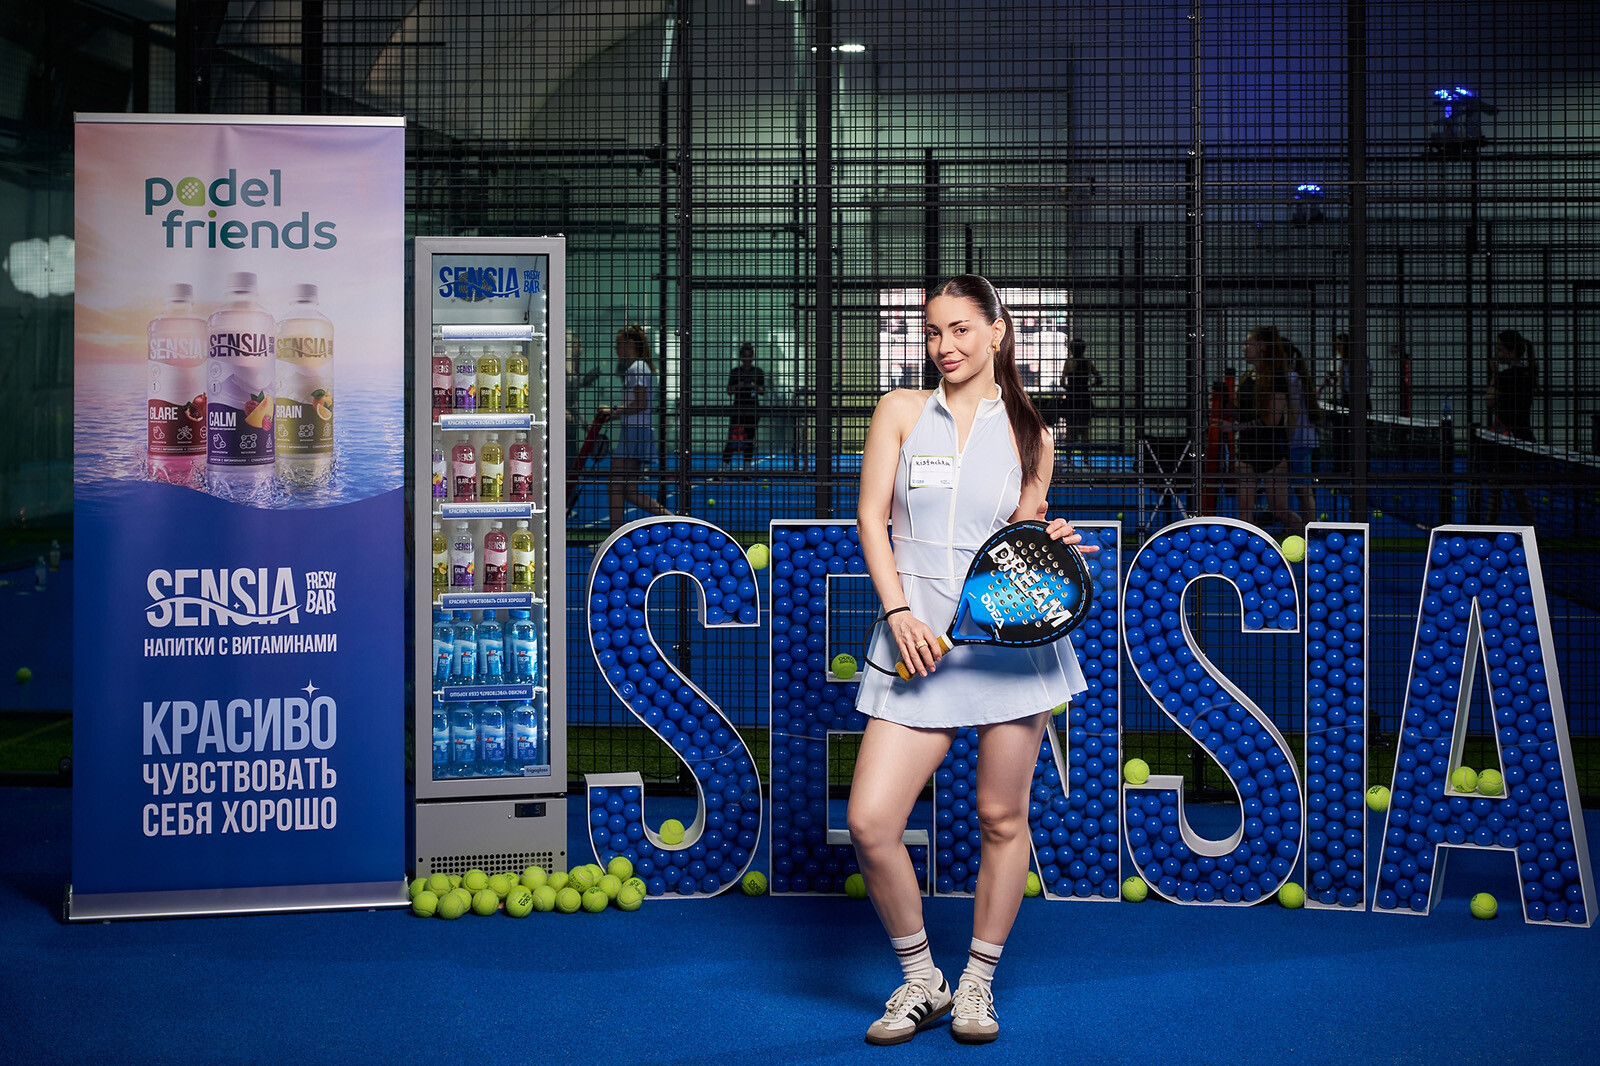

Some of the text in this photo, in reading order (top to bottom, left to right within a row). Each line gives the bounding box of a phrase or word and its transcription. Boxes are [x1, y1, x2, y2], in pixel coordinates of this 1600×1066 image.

[145, 168, 281, 216] padel
[162, 209, 338, 250] friends
[438, 266, 521, 298] SENSIA
[523, 270, 541, 280] FRESH
[523, 280, 541, 294] BAR
[209, 333, 268, 358] SENSIA
[276, 337, 327, 359] SENSIA
[150, 407, 178, 420] GLARE
[209, 411, 236, 427] CALM
[276, 405, 302, 419] BRAIN
[305, 571, 336, 590] FRESH
[987, 540, 1072, 628] DREAM
[145, 567, 301, 628] SENSIA
[305, 589, 336, 615] BAR
[981, 592, 1005, 630] ODEA
[144, 633, 337, 657] НАПИТКИ С ВИТАМИНАМИ
[143, 696, 337, 756] КРАСИВО
[585, 516, 1598, 928] SENSIA
[143, 757, 337, 796] ЧУВСТВОВАТЬ
[143, 796, 337, 837] СЕБЯ ХОРОШО
